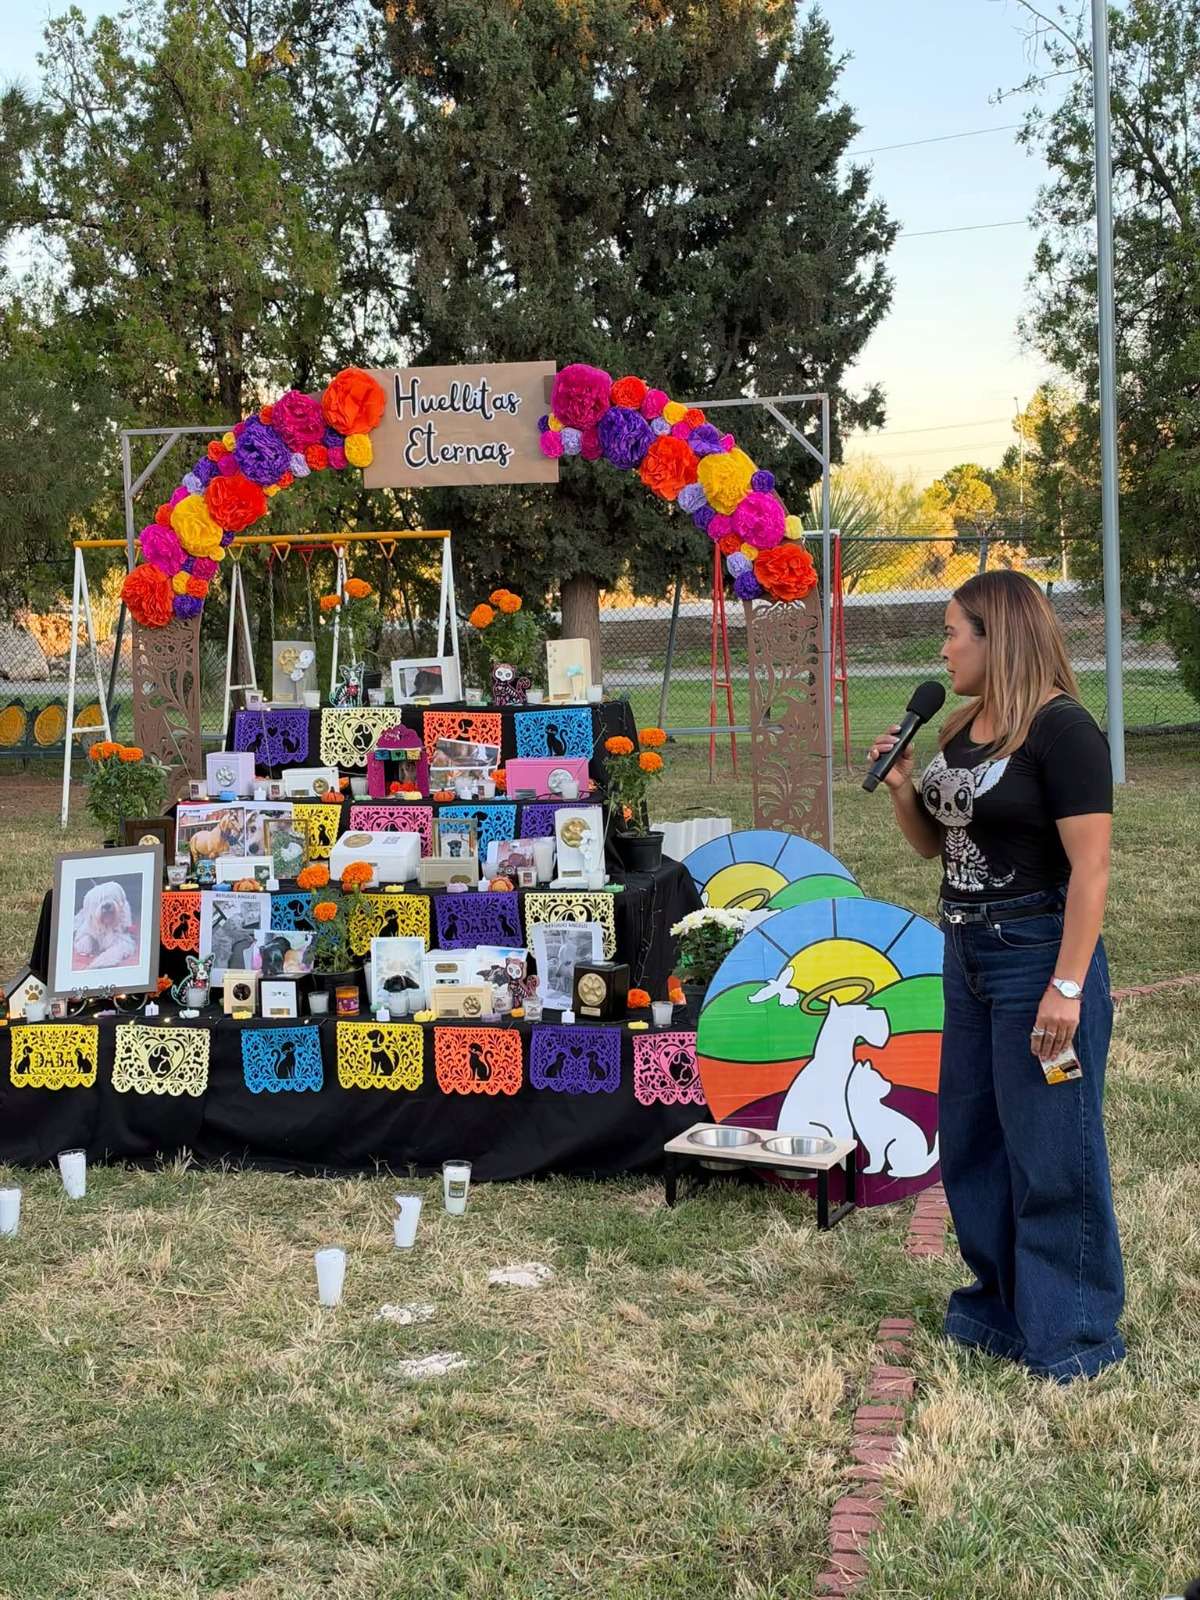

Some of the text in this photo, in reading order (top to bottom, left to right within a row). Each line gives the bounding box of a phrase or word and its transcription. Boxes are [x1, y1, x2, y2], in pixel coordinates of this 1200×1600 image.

[394, 374, 521, 420] Huellitas
[404, 421, 513, 468] Eternas
[34, 1050, 75, 1068] DABA
